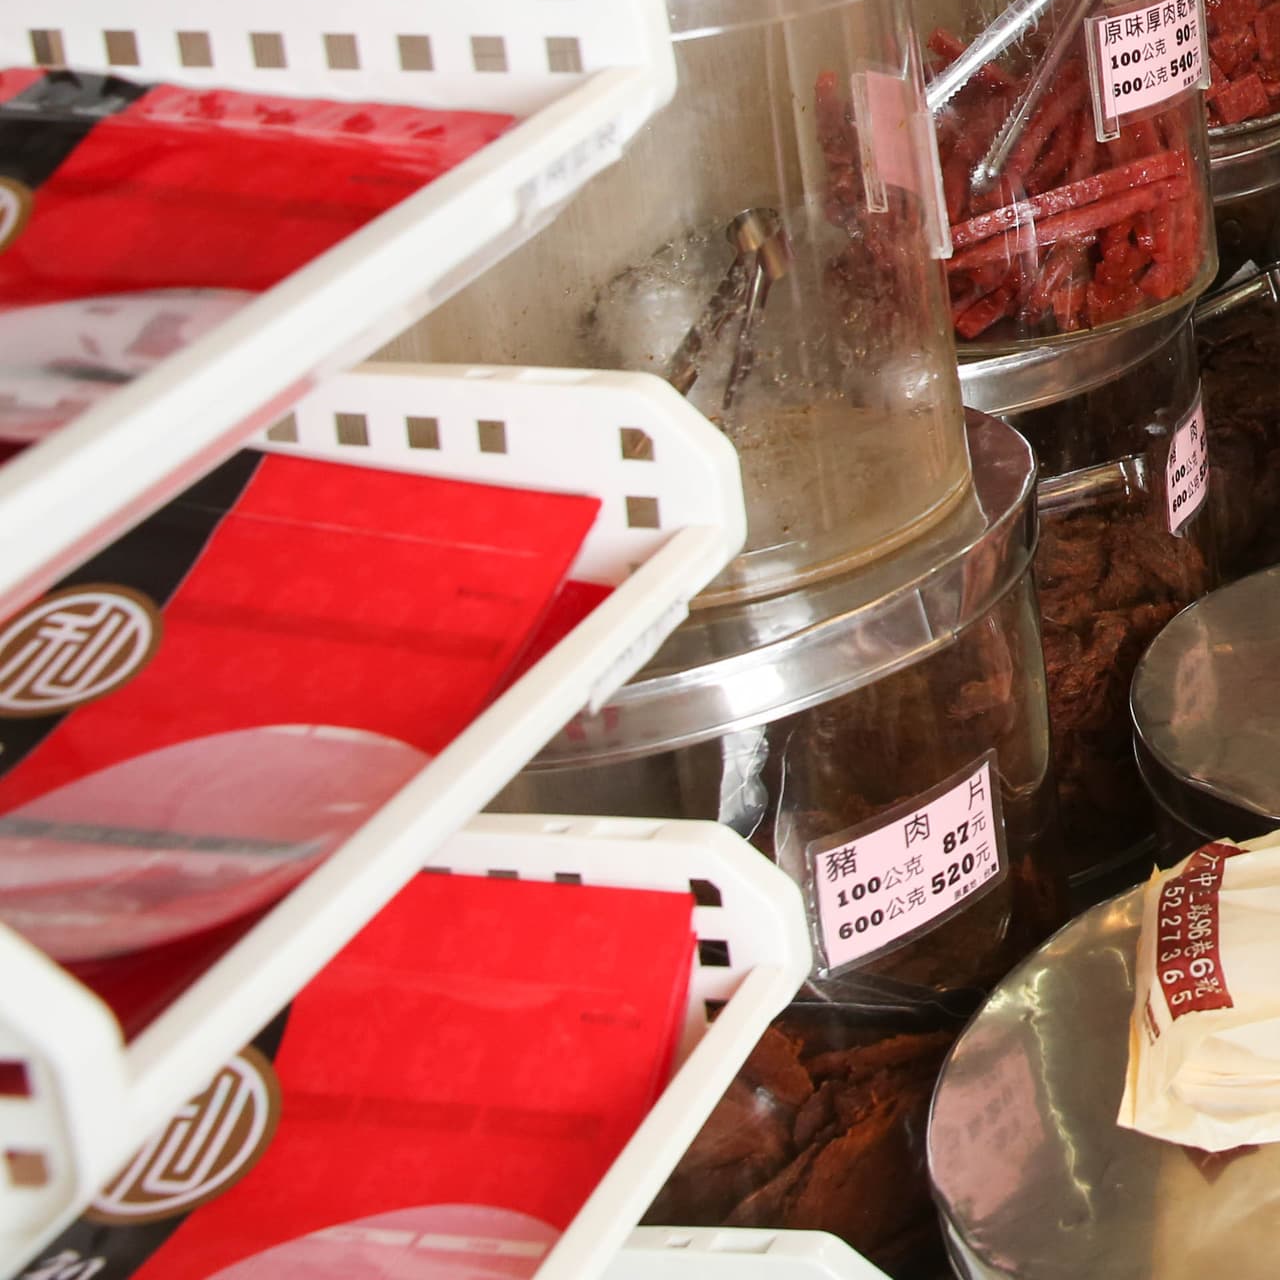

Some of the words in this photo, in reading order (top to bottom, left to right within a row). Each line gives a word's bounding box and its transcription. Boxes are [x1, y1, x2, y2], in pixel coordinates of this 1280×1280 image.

[1111, 38, 1167, 70] 100公克
[826, 773, 986, 882] 豬肉片
[837, 854, 925, 907] 100公克
[943, 811, 987, 855] 87元
[838, 886, 928, 939] 600公克
[931, 841, 991, 895] 520元
